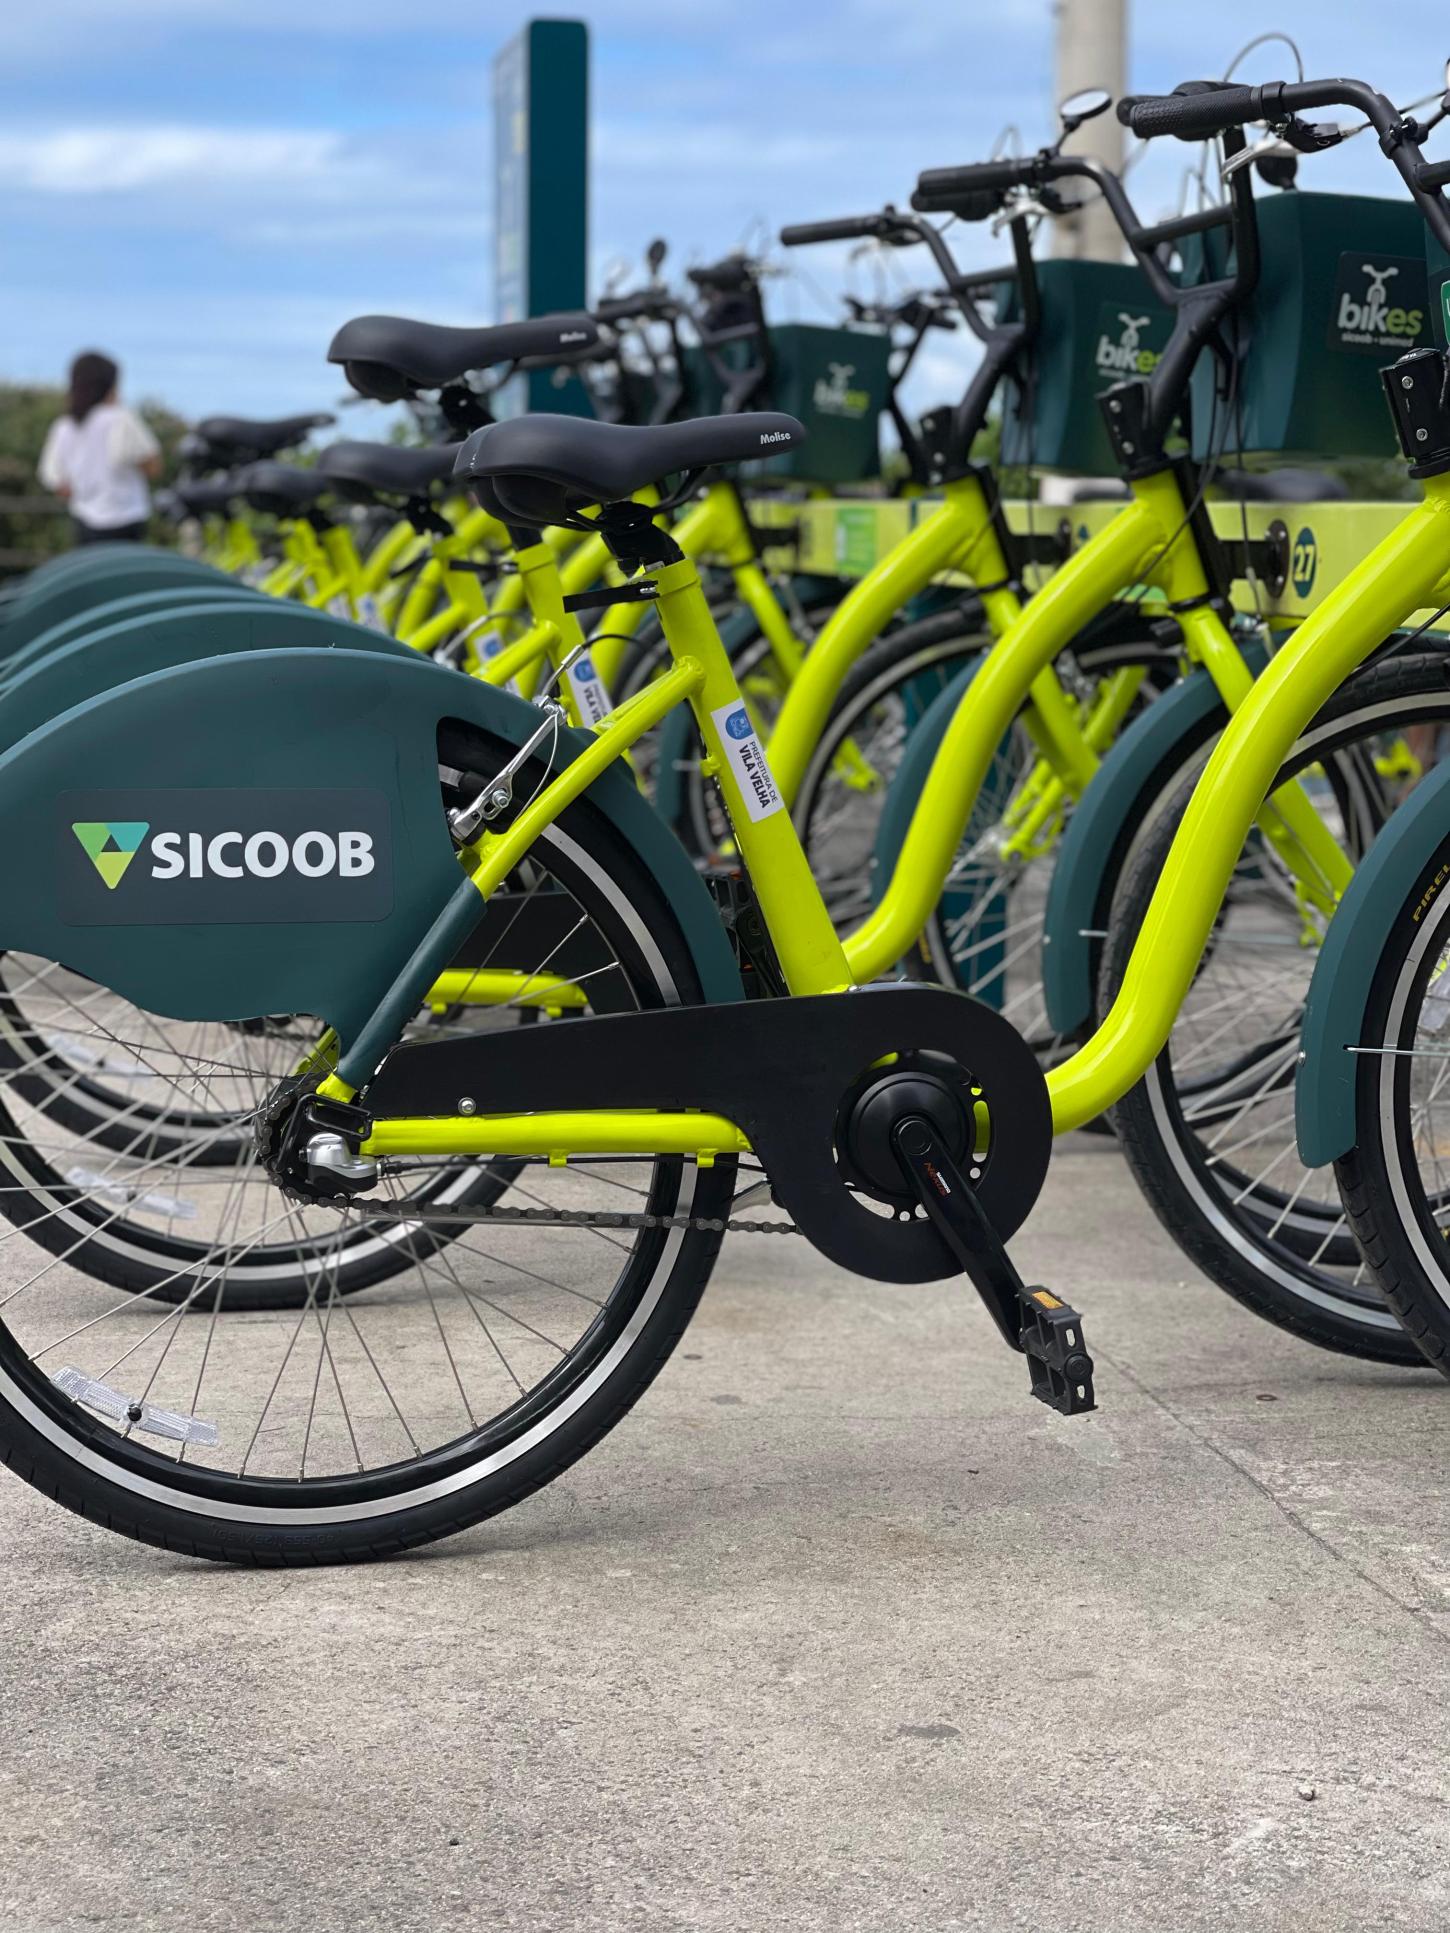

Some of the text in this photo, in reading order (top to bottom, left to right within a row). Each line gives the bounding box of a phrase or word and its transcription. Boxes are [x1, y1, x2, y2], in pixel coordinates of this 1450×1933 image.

[1337, 292, 1423, 336] bikes
[760, 431, 791, 444] Molise
[1294, 544, 1314, 581] 27
[739, 744, 771, 809] VILA VELHA
[749, 740, 778, 803] PREFEITURA DE
[151, 831, 375, 879] SICOOB
